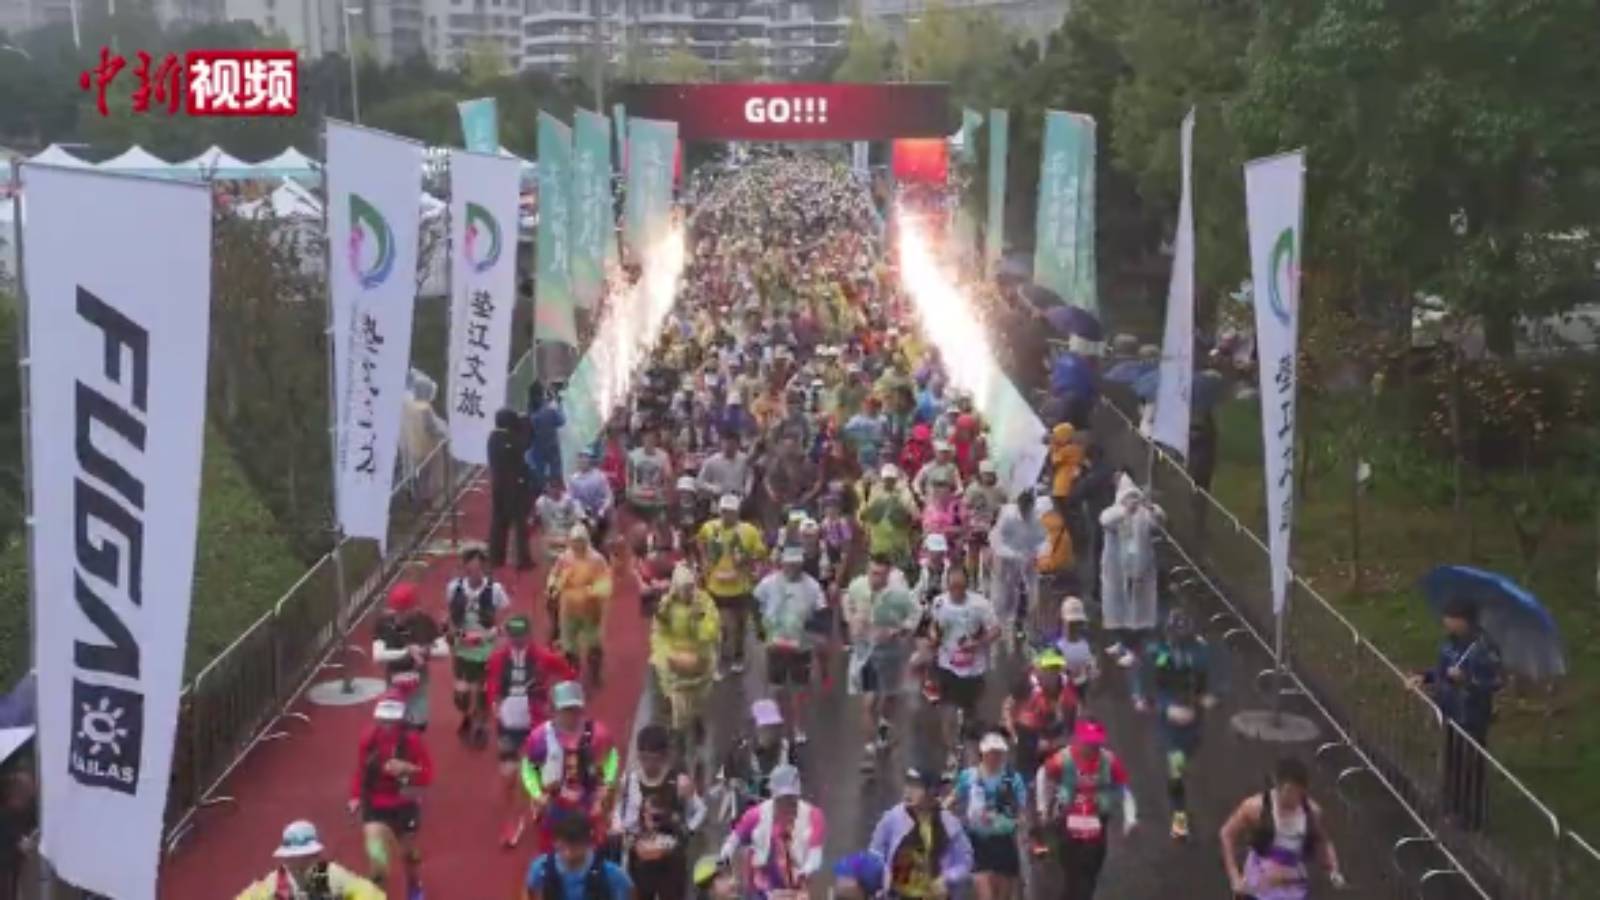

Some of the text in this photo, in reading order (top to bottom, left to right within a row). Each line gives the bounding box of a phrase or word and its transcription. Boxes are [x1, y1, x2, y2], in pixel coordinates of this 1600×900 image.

[745, 97, 828, 123] GO!!!
[456, 290, 495, 419] 垫江文旅
[74, 284, 149, 680] FUGA
